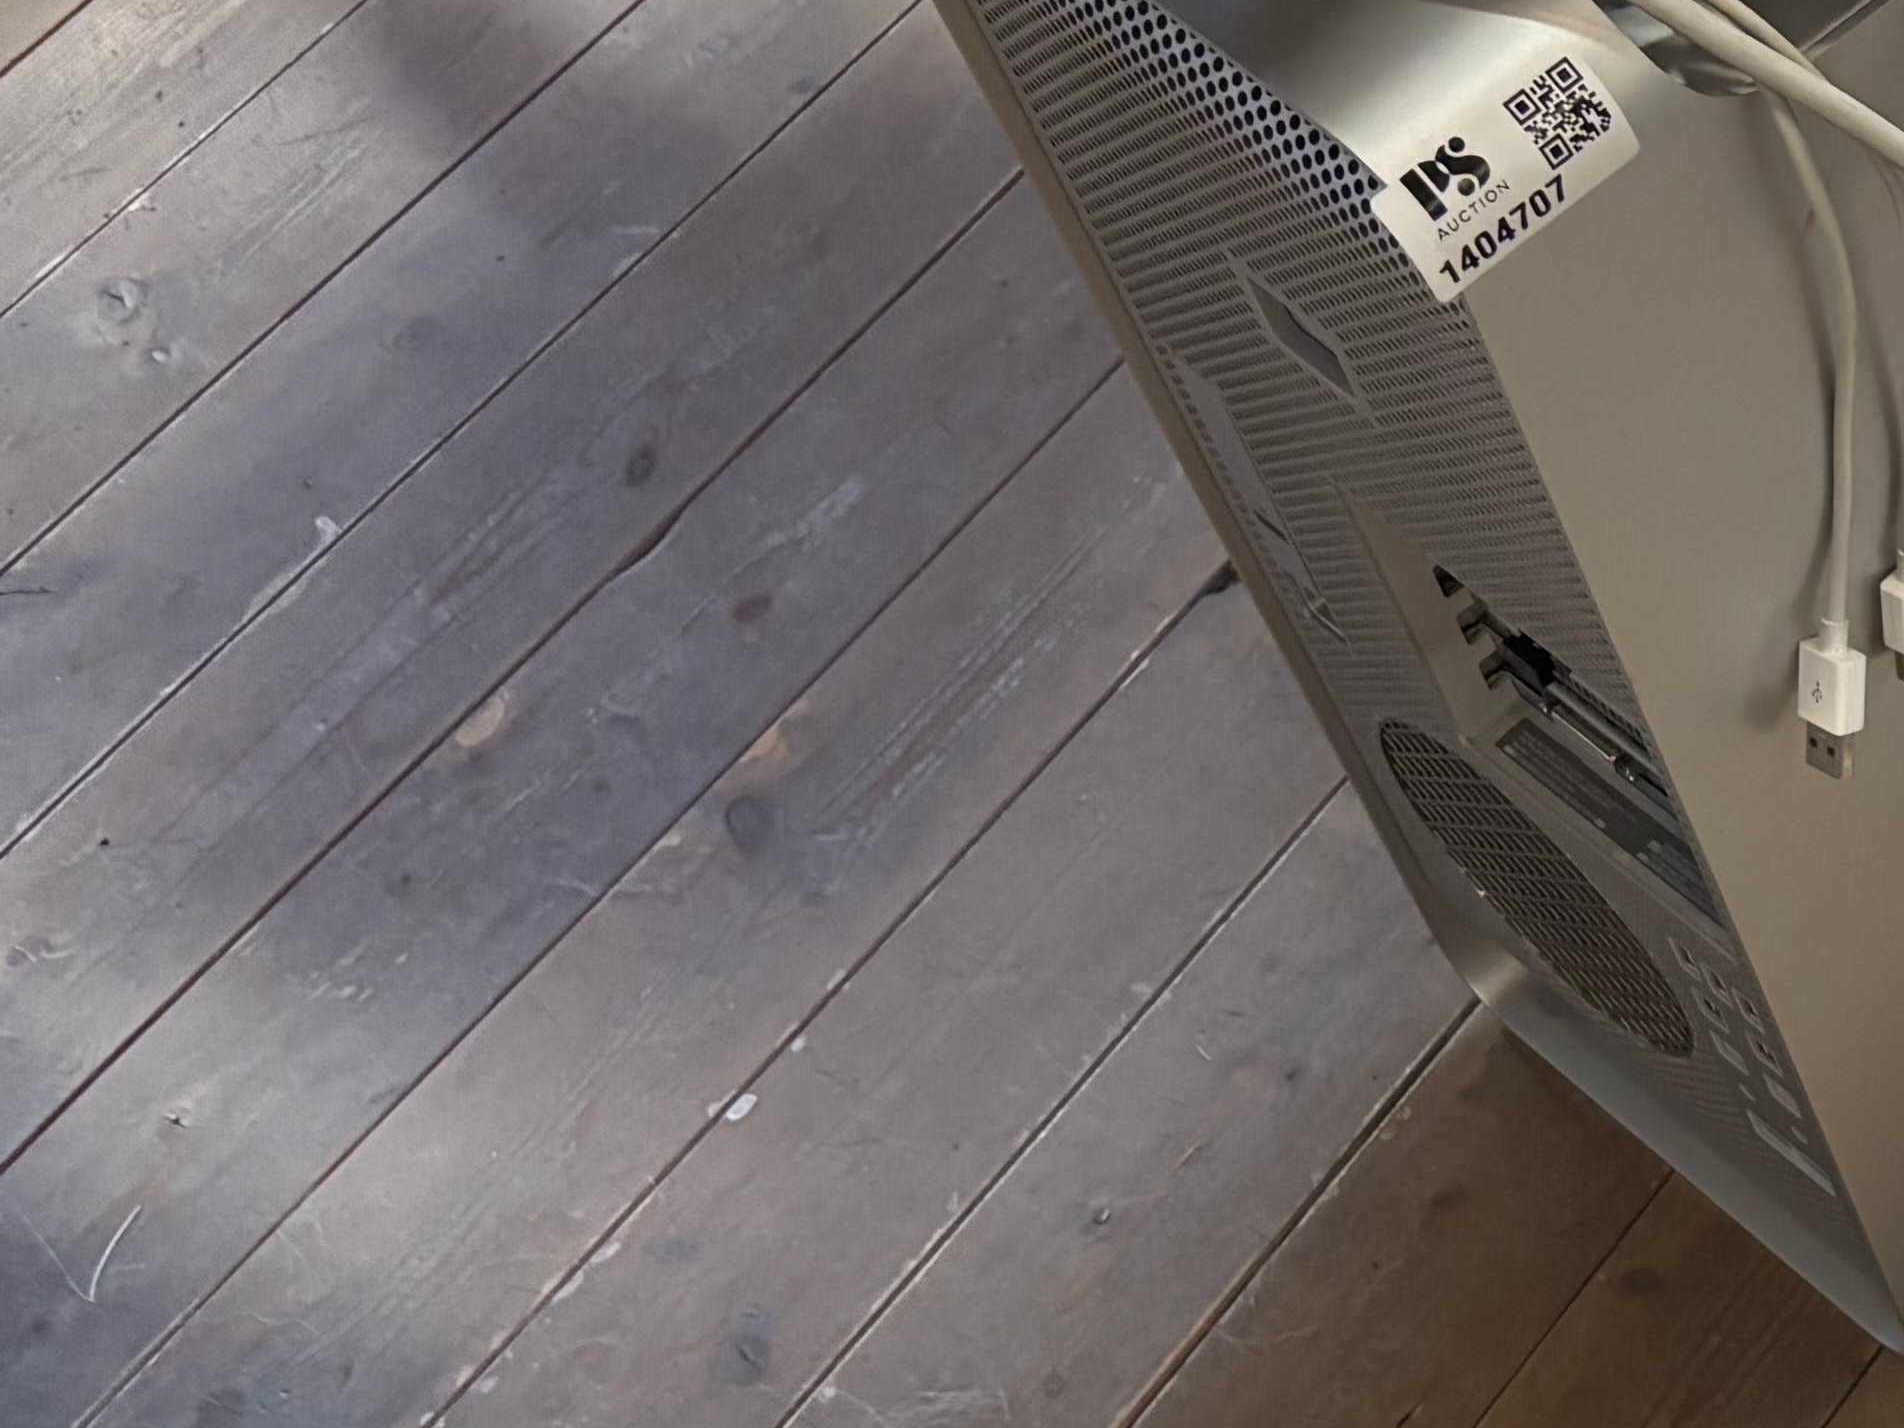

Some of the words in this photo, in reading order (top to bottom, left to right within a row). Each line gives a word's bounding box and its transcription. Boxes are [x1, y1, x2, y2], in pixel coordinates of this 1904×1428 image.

[1400, 136, 1491, 222] PS
[1436, 178, 1511, 242] AUCTION
[1439, 173, 1567, 284] 1404707
